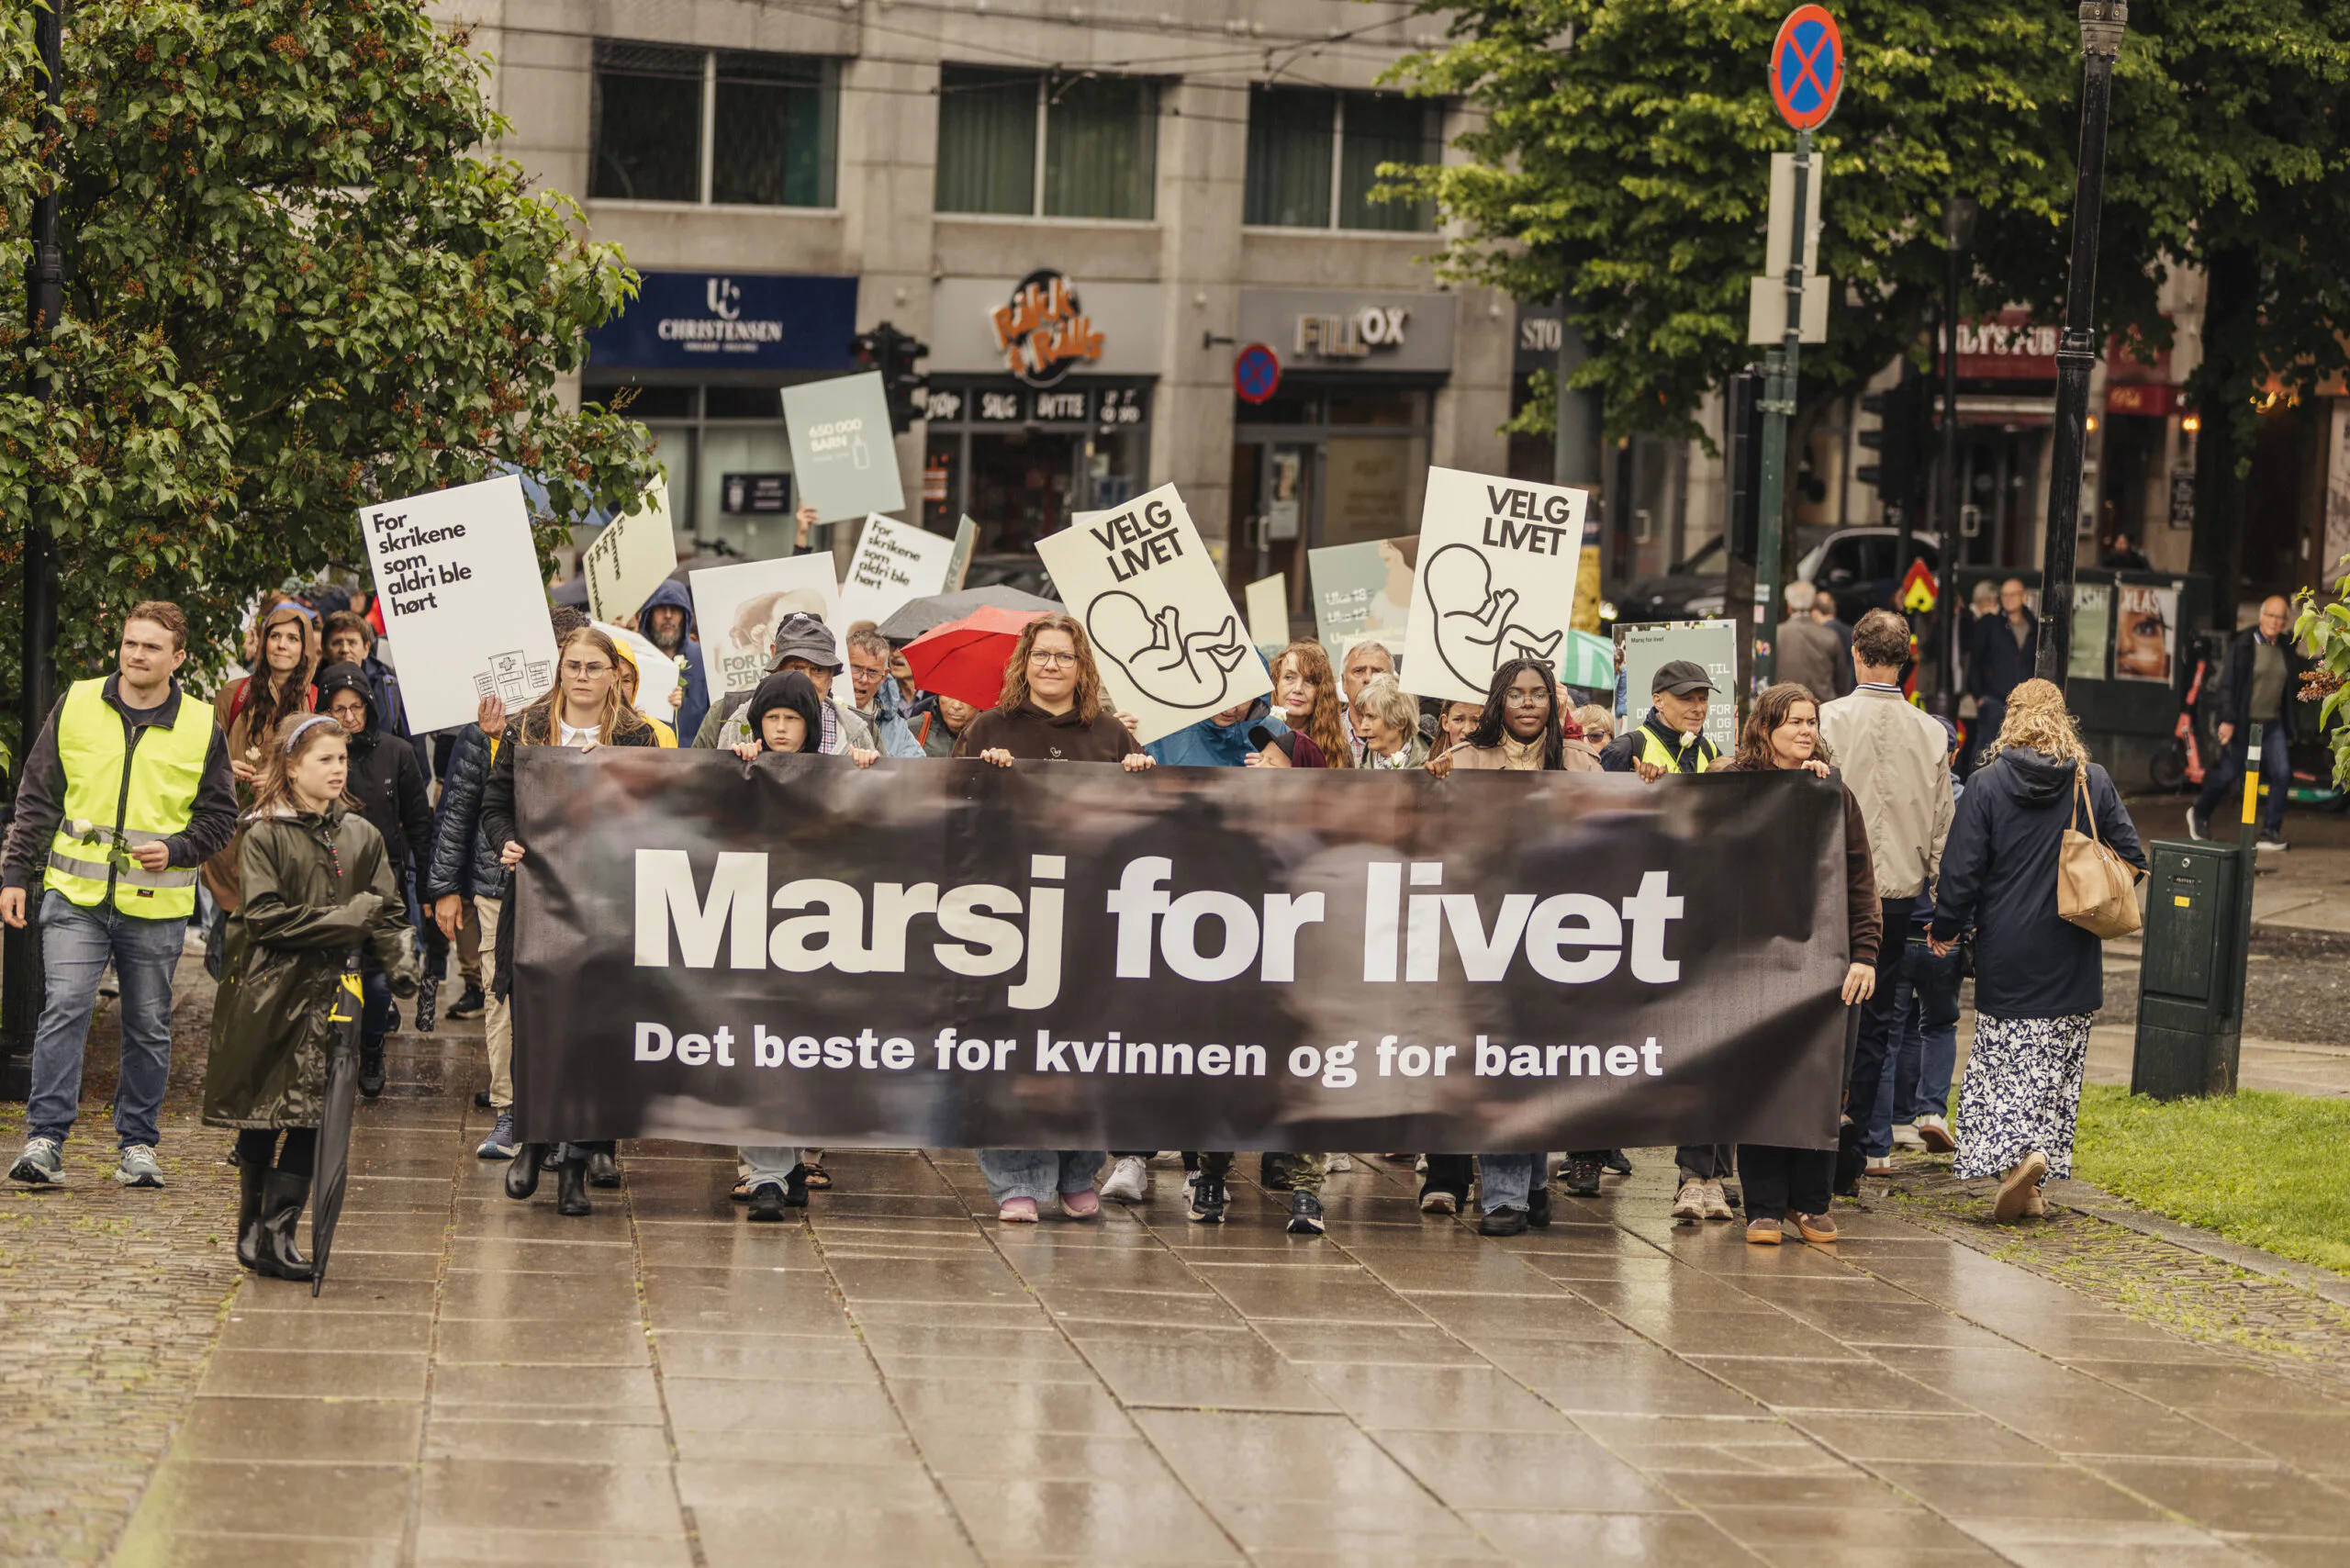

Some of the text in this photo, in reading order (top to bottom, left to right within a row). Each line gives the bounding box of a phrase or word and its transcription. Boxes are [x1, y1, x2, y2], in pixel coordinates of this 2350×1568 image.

[658, 319, 783, 342] CHRISTENSEN
[1521, 317, 1561, 351] STO
[925, 392, 961, 420] JØP
[835, 419, 863, 433] 000
[811, 434, 847, 453] BARN
[1487, 485, 1570, 524] VELG
[372, 512, 408, 533] For
[617, 515, 625, 536] En
[872, 521, 893, 536] For
[1089, 500, 1172, 551] VELG
[379, 524, 466, 554] skrikene
[867, 534, 922, 562] skrikene
[1483, 517, 1566, 555] LIVET
[384, 554, 427, 575] som
[595, 543, 601, 564] de
[609, 526, 621, 581] stemme
[864, 549, 890, 564] som
[1106, 527, 1184, 583] LIVET
[387, 561, 472, 596] aldri ble
[854, 570, 882, 589] hørt
[858, 561, 911, 587] aldri ble
[391, 592, 438, 616] hørt
[2122, 588, 2160, 614] XLAS
[723, 654, 756, 672] FOR
[1708, 664, 1730, 675] TIL
[1709, 704, 1731, 715] FOR
[1717, 718, 1731, 729] OG
[634, 848, 1684, 1010] Marsj for livet
[634, 1021, 1663, 1089] Det beste for kvinnen og for barnet
